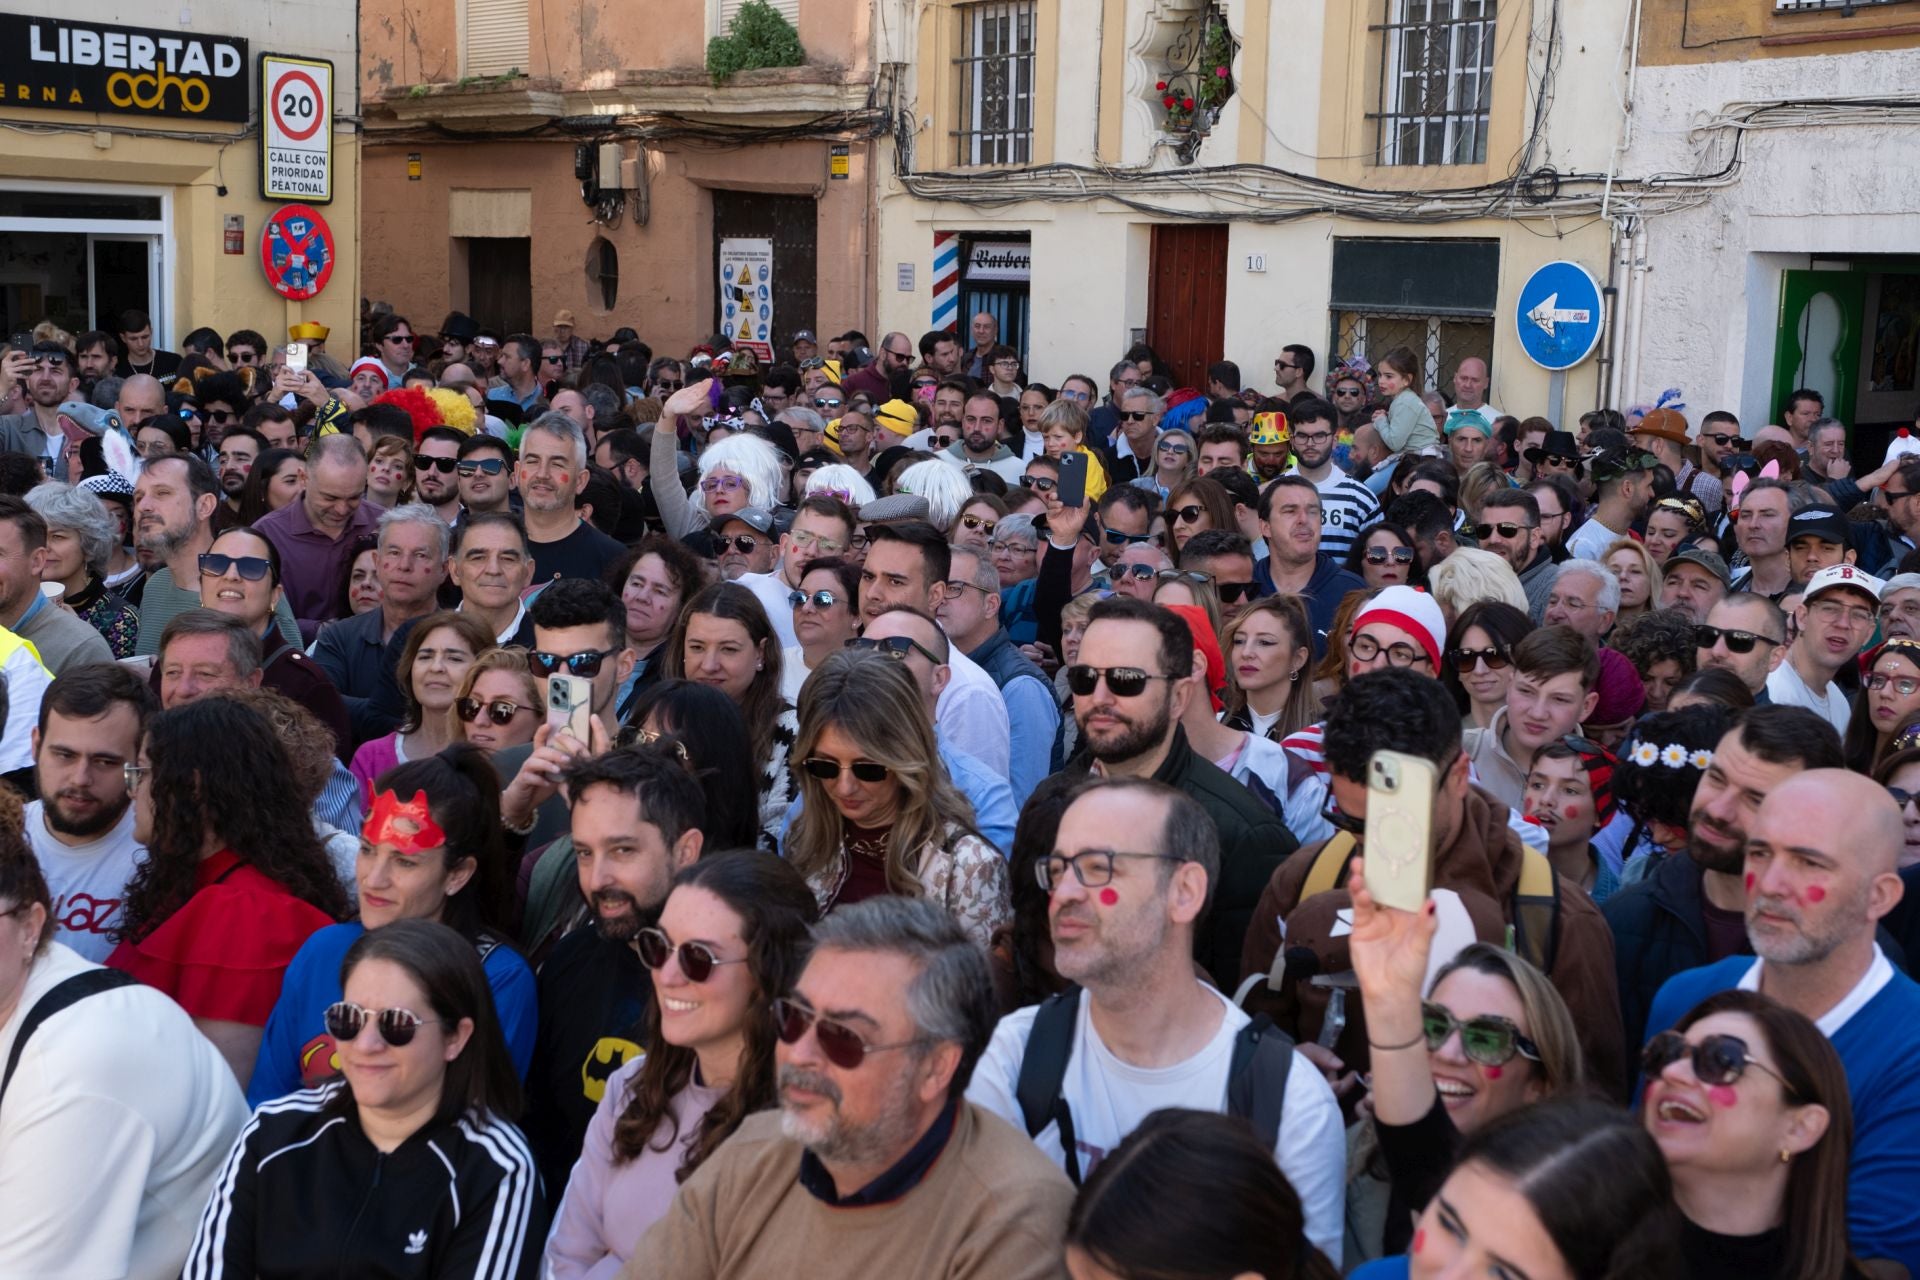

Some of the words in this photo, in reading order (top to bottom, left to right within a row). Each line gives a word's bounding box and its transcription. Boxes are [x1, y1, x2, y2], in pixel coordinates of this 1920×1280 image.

[30, 24, 242, 78] LIBERTAD
[283, 93, 314, 118] 20
[270, 152, 301, 164] CALLE
[304, 155, 326, 166] CON
[272, 166, 324, 180] PRIORIDAD
[271, 180, 324, 194] PEATONAL
[976, 249, 1031, 270] Barber
[1247, 255, 1263, 271] 10
[1840, 567, 1854, 579] B
